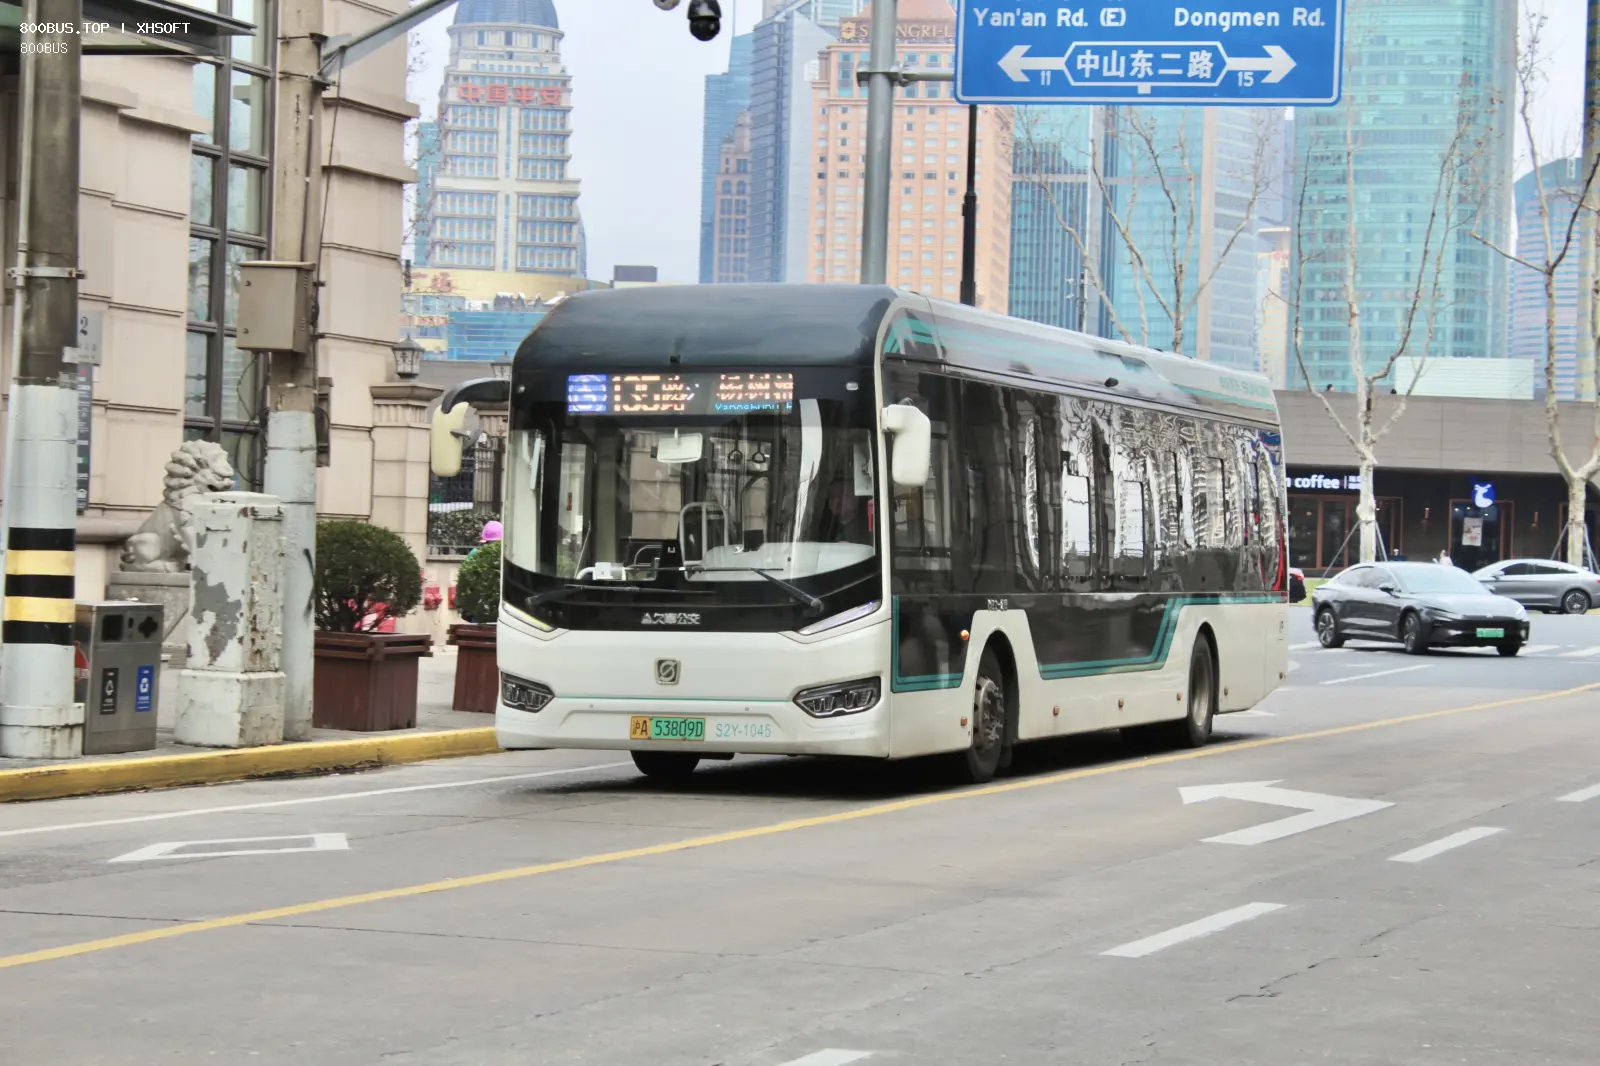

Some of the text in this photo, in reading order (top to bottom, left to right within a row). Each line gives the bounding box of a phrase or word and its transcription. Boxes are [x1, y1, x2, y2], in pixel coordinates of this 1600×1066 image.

[973, 8, 1126, 27] Yan'an Rd. (E)
[1174, 8, 1325, 32] Dongmen Rd.
[859, 23, 953, 38] SNGRI-L
[1076, 50, 1213, 79] 中山东二路
[1040, 71, 1050, 86] 11
[1238, 71, 1254, 87] 15
[458, 80, 562, 106] 中国平安
[1294, 474, 1340, 489] coffee
[654, 720, 704, 738] 53809D
[715, 723, 772, 738] S2Y-1045
